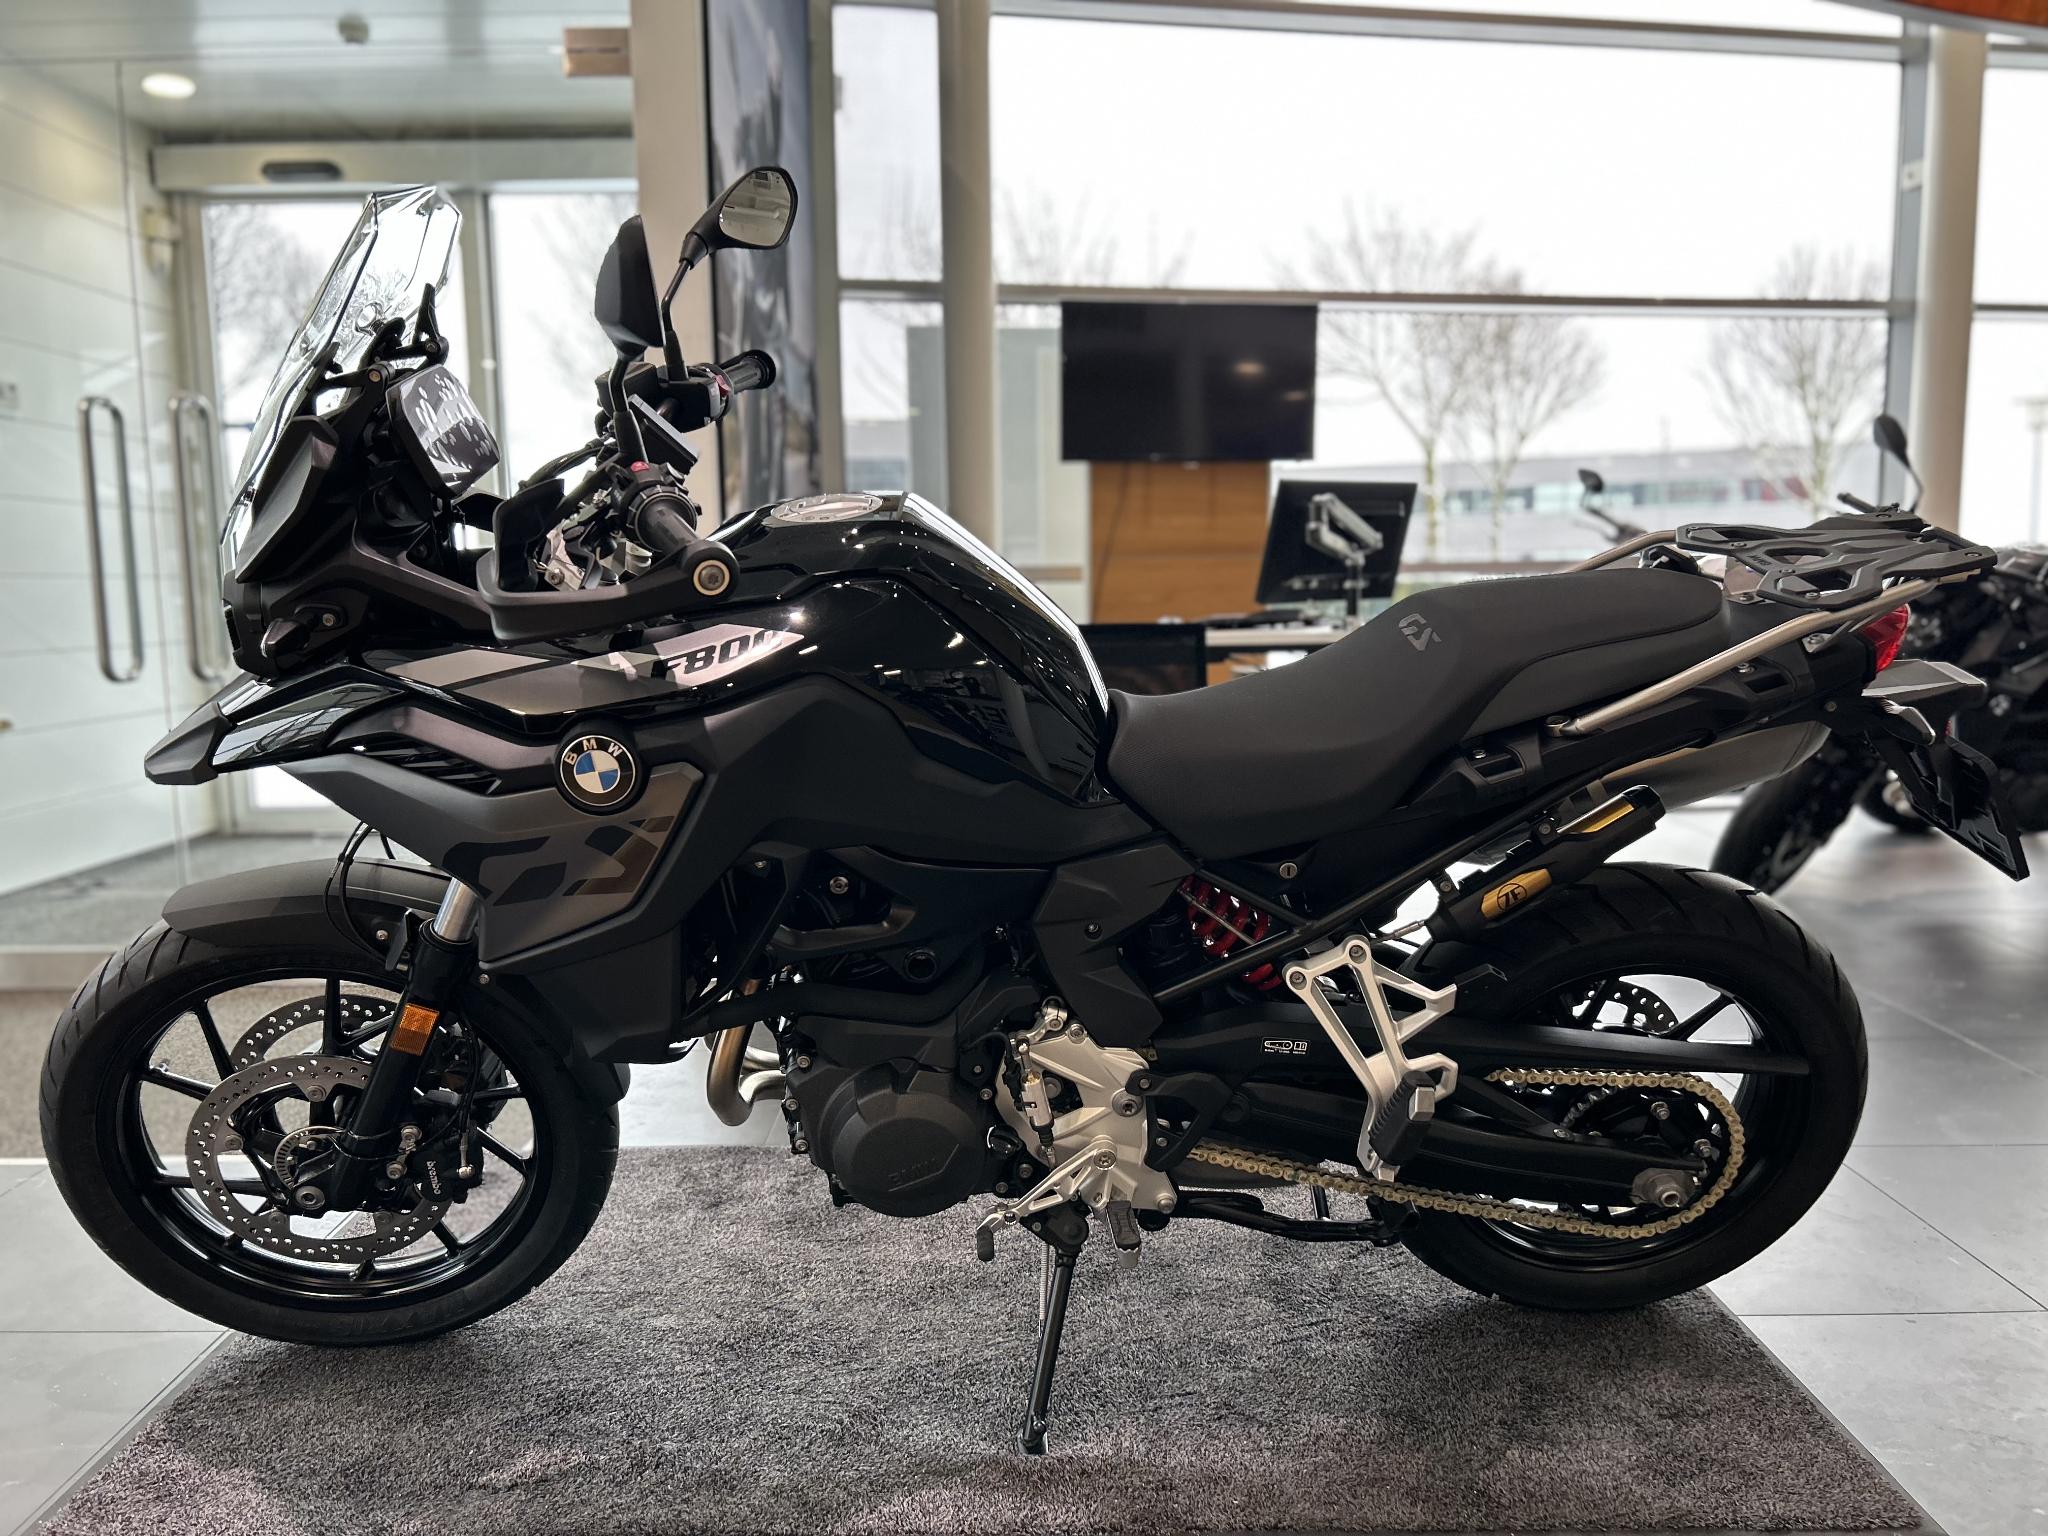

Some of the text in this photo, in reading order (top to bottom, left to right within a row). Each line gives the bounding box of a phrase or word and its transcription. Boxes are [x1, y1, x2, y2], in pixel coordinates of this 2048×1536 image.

[1399, 613, 1442, 651] GS
[564, 738, 623, 766] BMW
[1499, 884, 1525, 912] ZF
[426, 1160, 441, 1194] brembo
